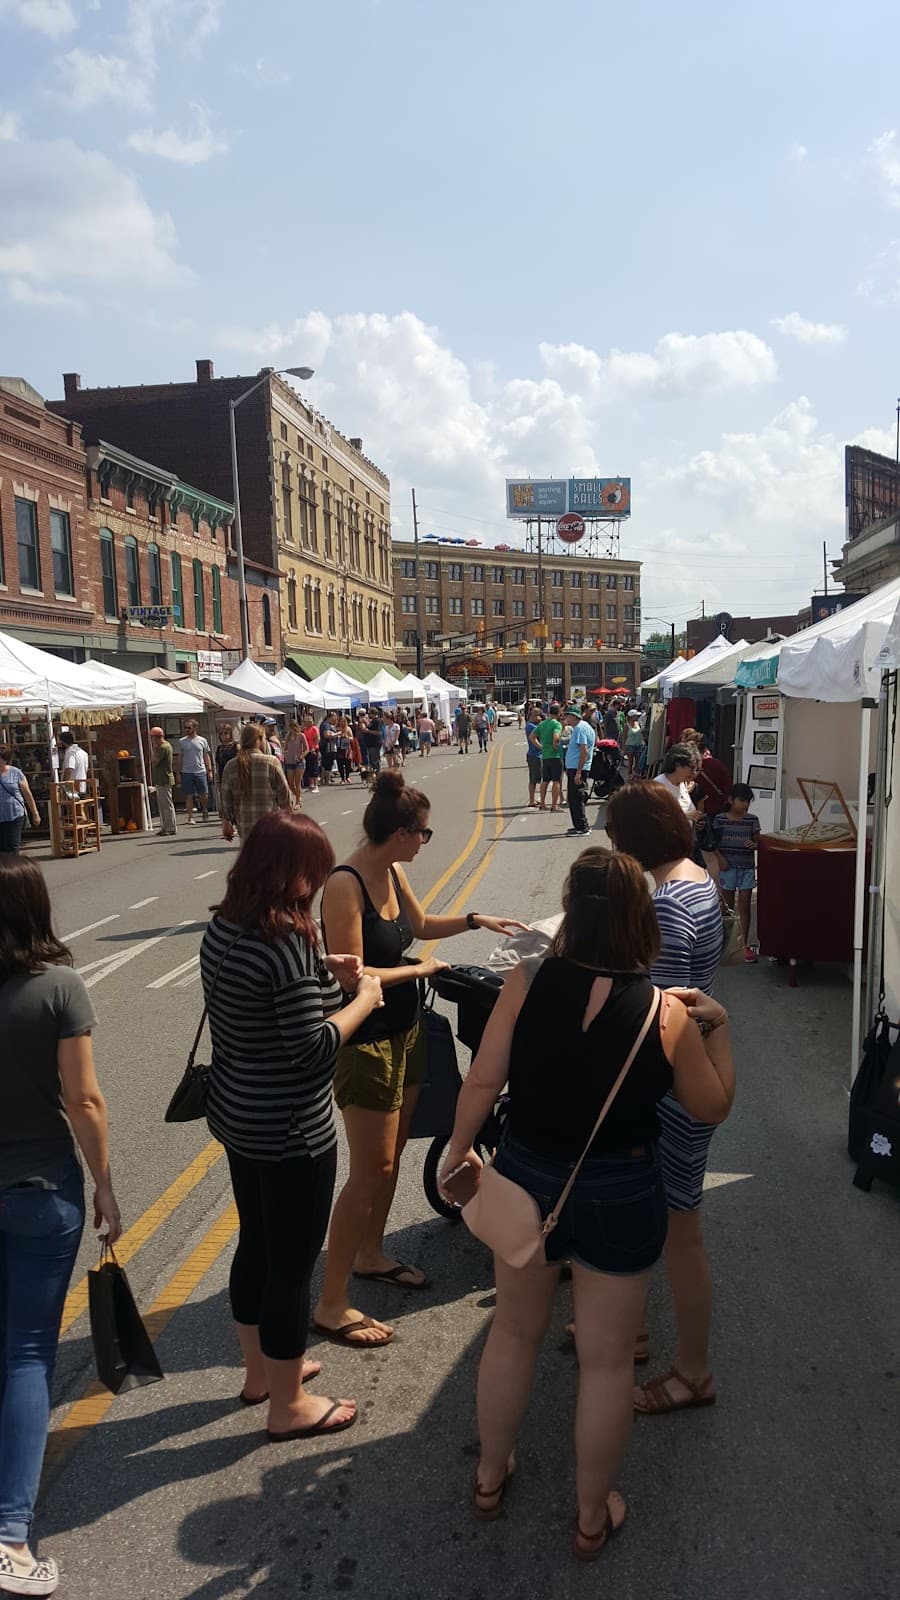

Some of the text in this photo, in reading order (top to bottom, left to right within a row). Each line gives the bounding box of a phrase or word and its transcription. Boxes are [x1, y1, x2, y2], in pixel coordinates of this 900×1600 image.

[573, 482, 602, 492] SMALL
[573, 493, 603, 504] BALLS
[130, 607, 172, 616] VINTAGE
